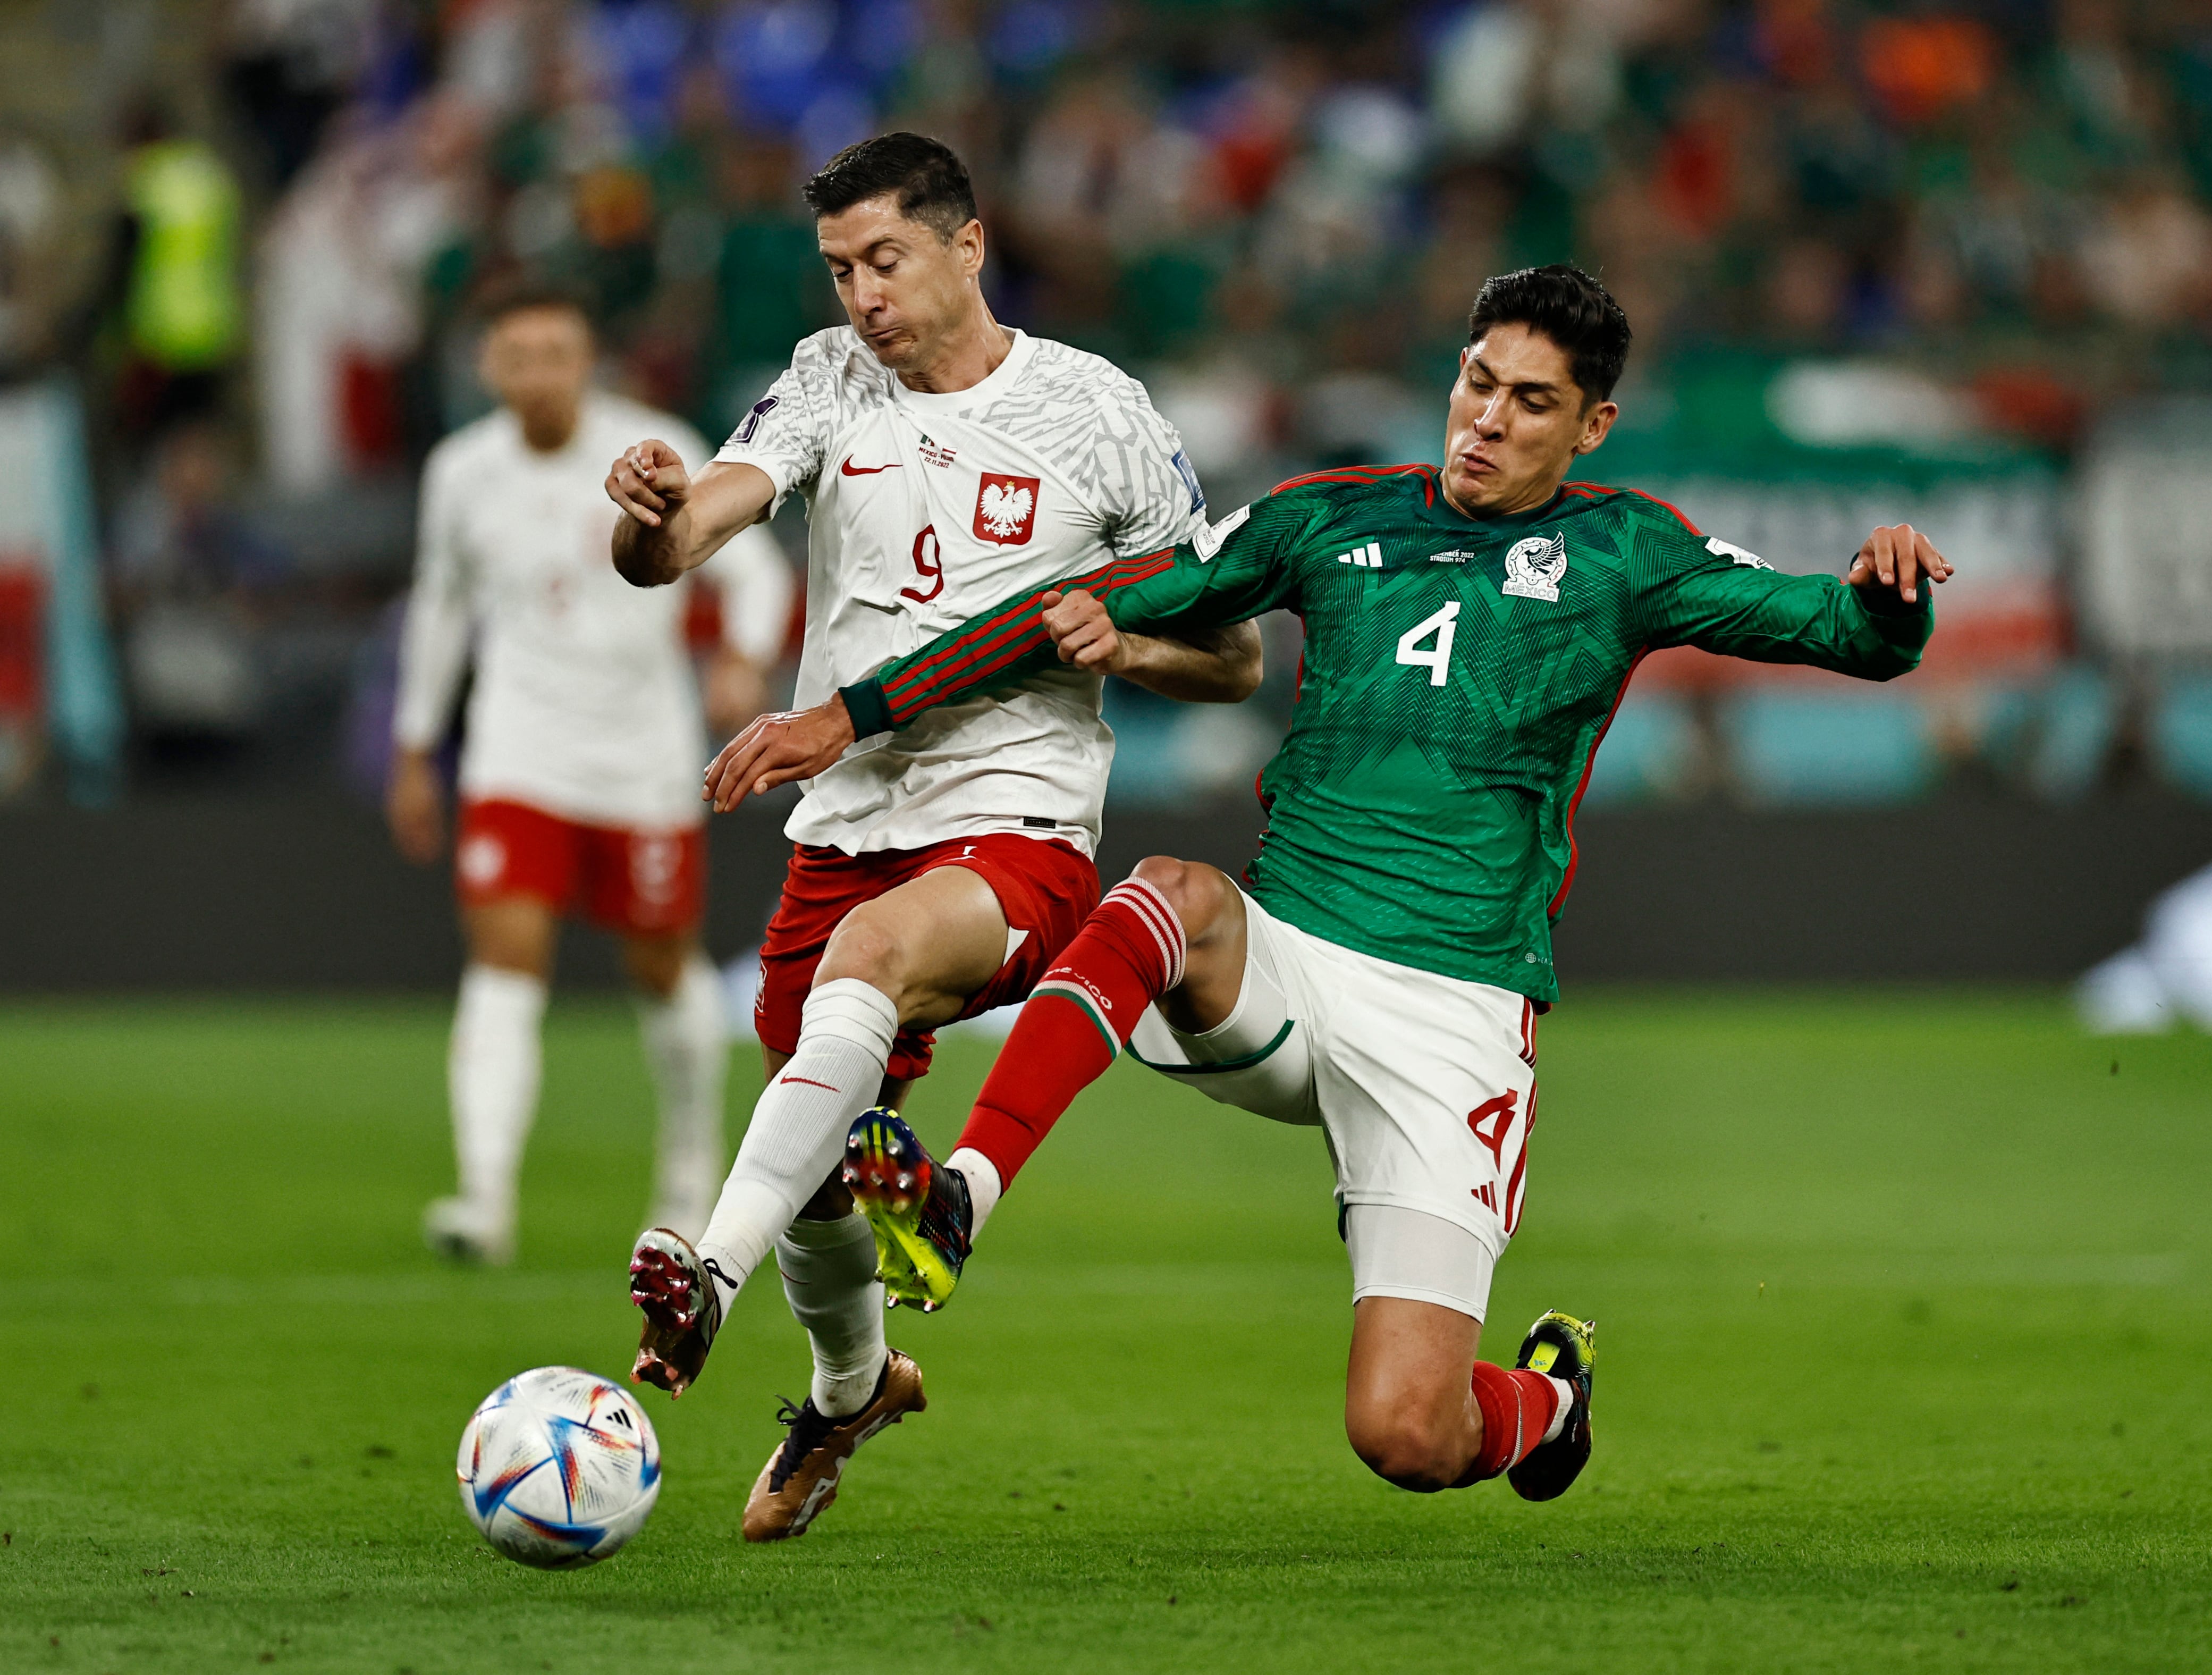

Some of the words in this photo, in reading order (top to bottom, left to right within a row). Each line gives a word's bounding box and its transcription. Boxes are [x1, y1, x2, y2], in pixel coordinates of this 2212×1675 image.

[918, 447, 938, 458] MEXICO
[924, 457, 949, 468] 22.11.2022
[900, 524, 944, 604] 9
[1504, 583, 1557, 600] MÉXICO
[1396, 601, 1460, 686] 4
[1467, 1088, 1518, 1175] 4
